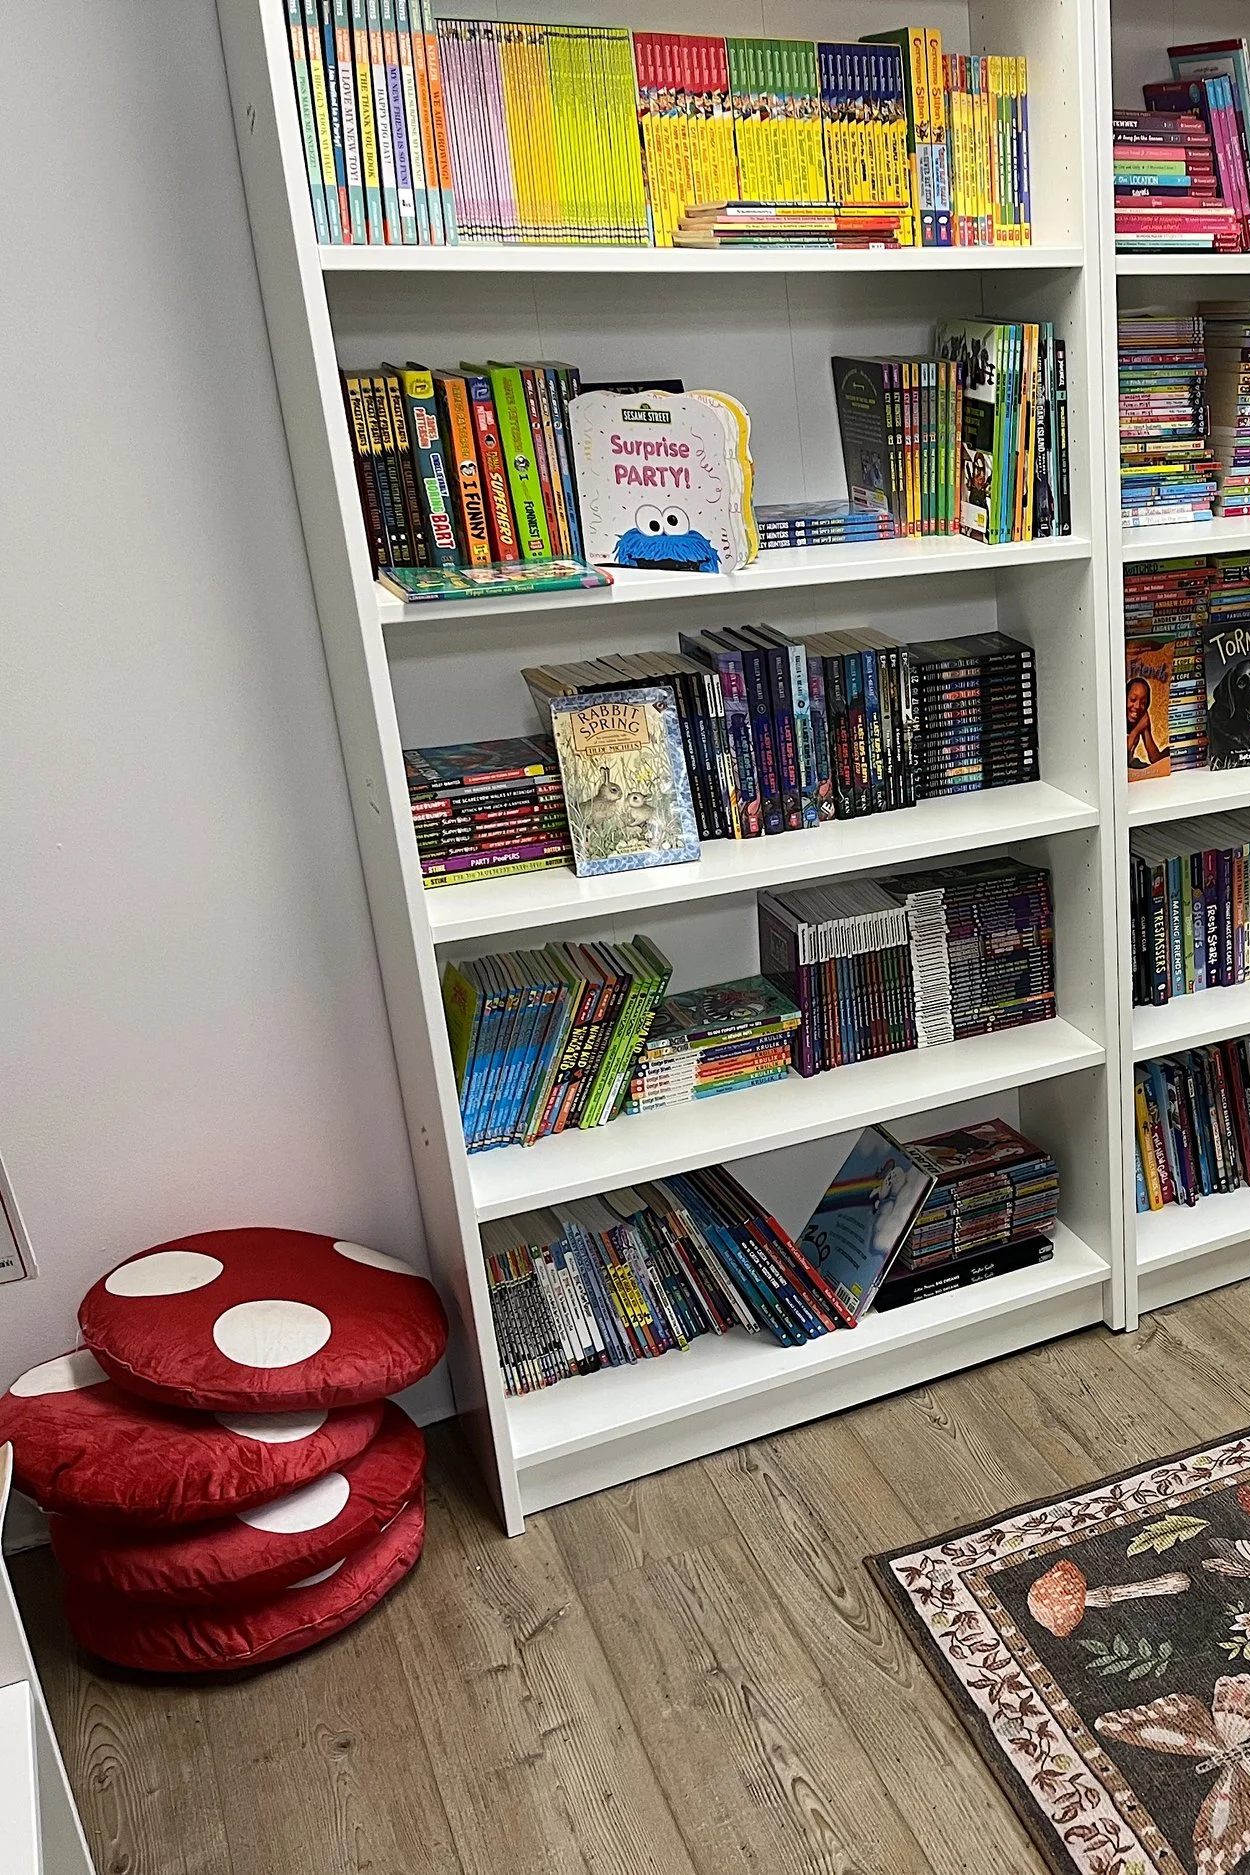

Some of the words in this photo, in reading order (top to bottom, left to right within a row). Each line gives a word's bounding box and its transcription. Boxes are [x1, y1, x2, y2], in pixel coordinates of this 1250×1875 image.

[913, 37, 923, 83] Geronimo
[342, 76, 351, 104] LOVE
[359, 72, 367, 91] THE
[377, 88, 386, 119] HAPPY
[432, 90, 440, 105] WE
[915, 86, 925, 118] Stilton
[345, 109, 353, 124] MY
[361, 94, 370, 126] THANK
[434, 109, 442, 128] ARE
[346, 126, 355, 150] NEW
[364, 130, 372, 149] YOU
[366, 151, 375, 177] BOOK
[398, 151, 405, 161] SO
[437, 130, 448, 179] GROWING!
[349, 155, 358, 180] TOY!
[1130, 176, 1158, 184] LOCATION
[624, 409, 647, 422] SESAME
[648, 411, 669, 423] STREET
[1035, 405, 1044, 424] DARK
[413, 407, 431, 448] PATTERSON
[425, 415, 438, 439] JAMES
[610, 434, 690, 461] Surprise
[1036, 426, 1045, 451] ISLAND
[462, 479, 478, 489] I
[614, 466, 690, 489] PARTY!
[424, 477, 443, 513] BORING
[464, 492, 487, 540] FUNNY
[487, 471, 514, 545] SUPERHERO
[431, 512, 454, 549] BART
[1154, 600, 1178, 608] ANDREW
[1176, 672, 1190, 680] COPE
[578, 705, 639, 724] RABBIT
[580, 717, 640, 738] SPRING
[872, 720, 880, 736] LAST
[873, 738, 881, 752] KIDS
[740, 736, 748, 752] LAST
[746, 776, 754, 797] EARTH
[875, 760, 884, 779] EARTH
[469, 856, 490, 866] PARTY
[430, 876, 447, 884] STINE
[1170, 900, 1180, 936] MAKING
[1193, 902, 1203, 948] GHOSTS
[1150, 908, 1168, 973] TRESPASSERS
[1173, 939, 1182, 975] FRIENDS
[638, 1010, 655, 1036] NINJA
[564, 1027, 580, 1054] NINJA
[584, 1024, 600, 1050] NINJA
[632, 1037, 647, 1055] KID
[755, 1041, 779, 1051] KRULIK
[758, 1032, 782, 1043] KRULIK
[559, 1055, 572, 1071] KID
[576, 1051, 590, 1068] KID
[751, 1054, 774, 1064] KRULIK
[749, 1068, 774, 1078] KRULIK
[750, 1075, 775, 1085] KRULIK
[1151, 1132, 1162, 1148] THE
[1154, 1147, 1165, 1164] NEW
[1157, 1164, 1169, 1184] GIRL
[747, 1251, 760, 1265] CATCH
[755, 1249, 768, 1262] CATCH
[934, 1278, 943, 1286] BIG
